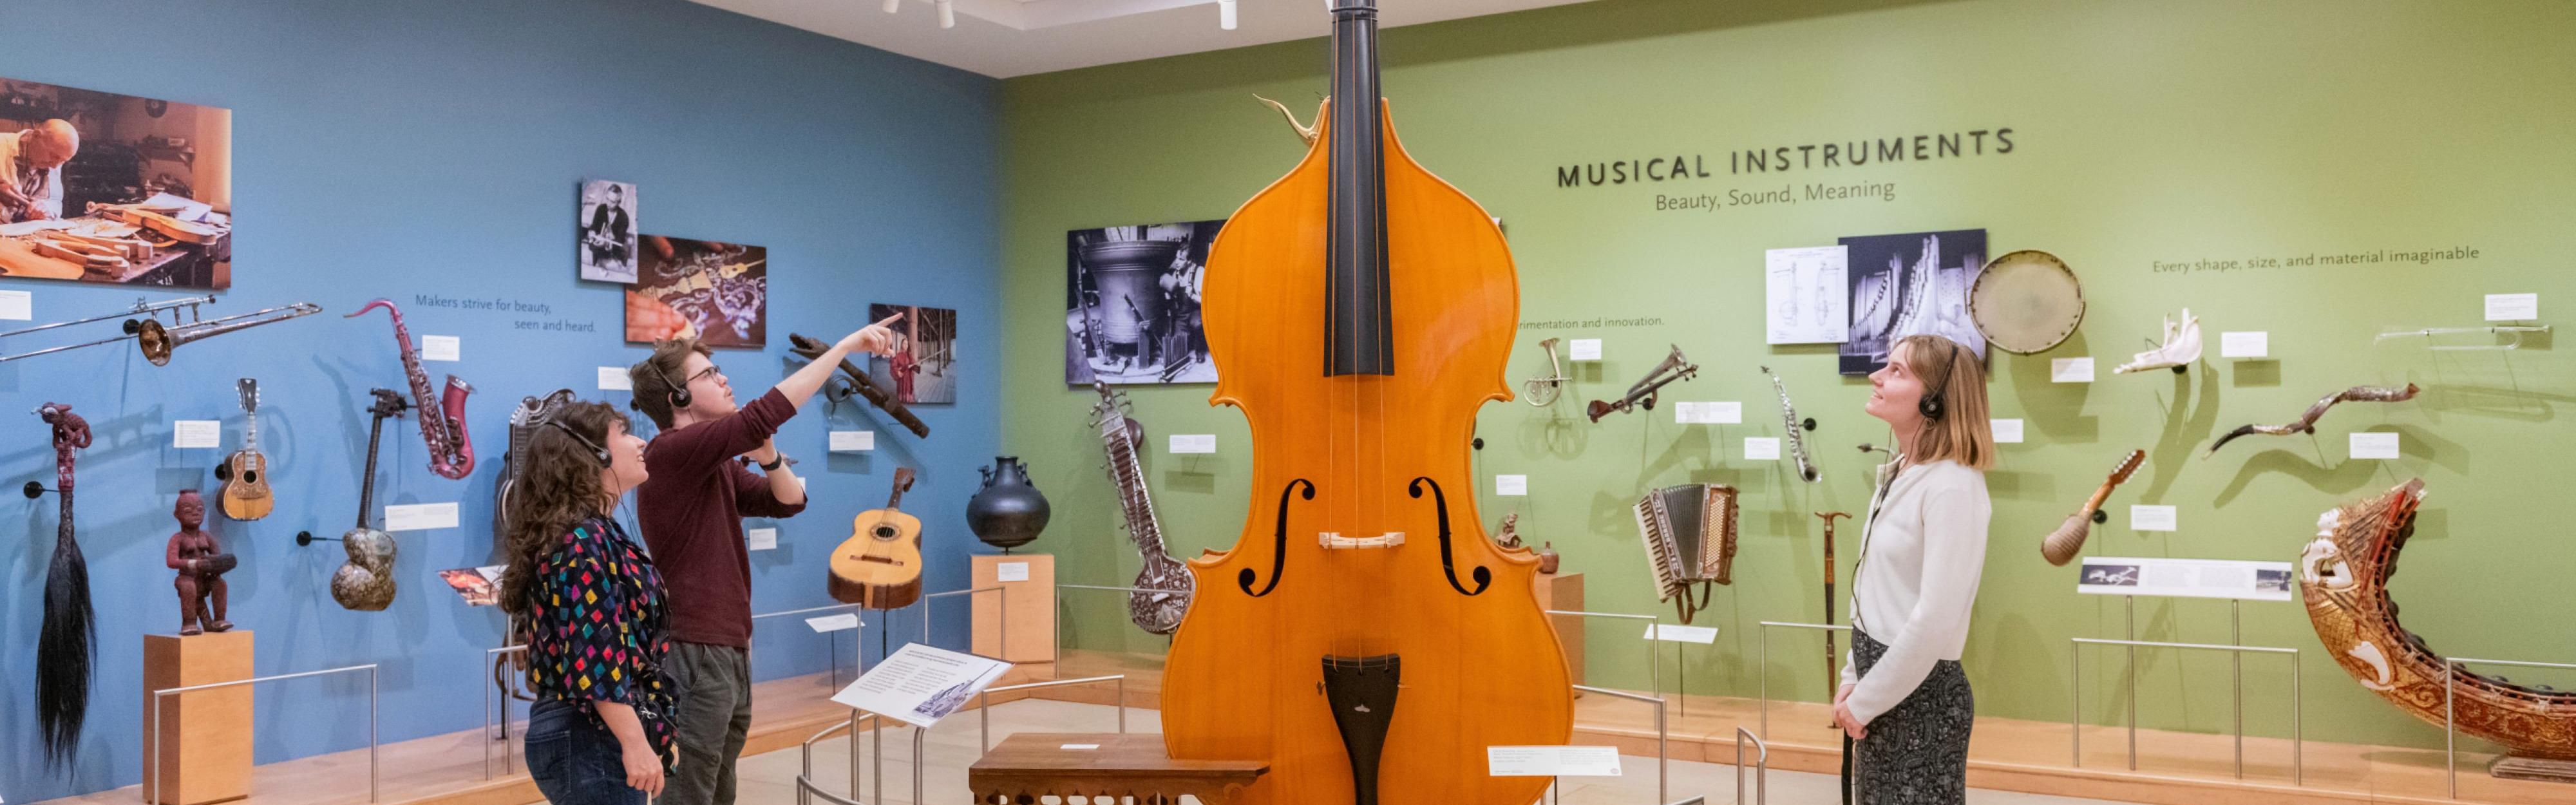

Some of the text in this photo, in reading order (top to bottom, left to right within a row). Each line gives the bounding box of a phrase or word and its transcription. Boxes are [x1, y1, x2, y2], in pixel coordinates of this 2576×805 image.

[1557, 127, 2015, 189] MUSICAL INSTRUMENTS
[1656, 179, 1896, 213] Beauty, Sound, Meaning
[2153, 245, 2480, 276] Every shape, size, and material imaginable
[415, 294, 552, 316] Makers strive for beauty,
[515, 320, 596, 333] seen and heard.
[1517, 316, 1665, 330] rimentation and innovation.
